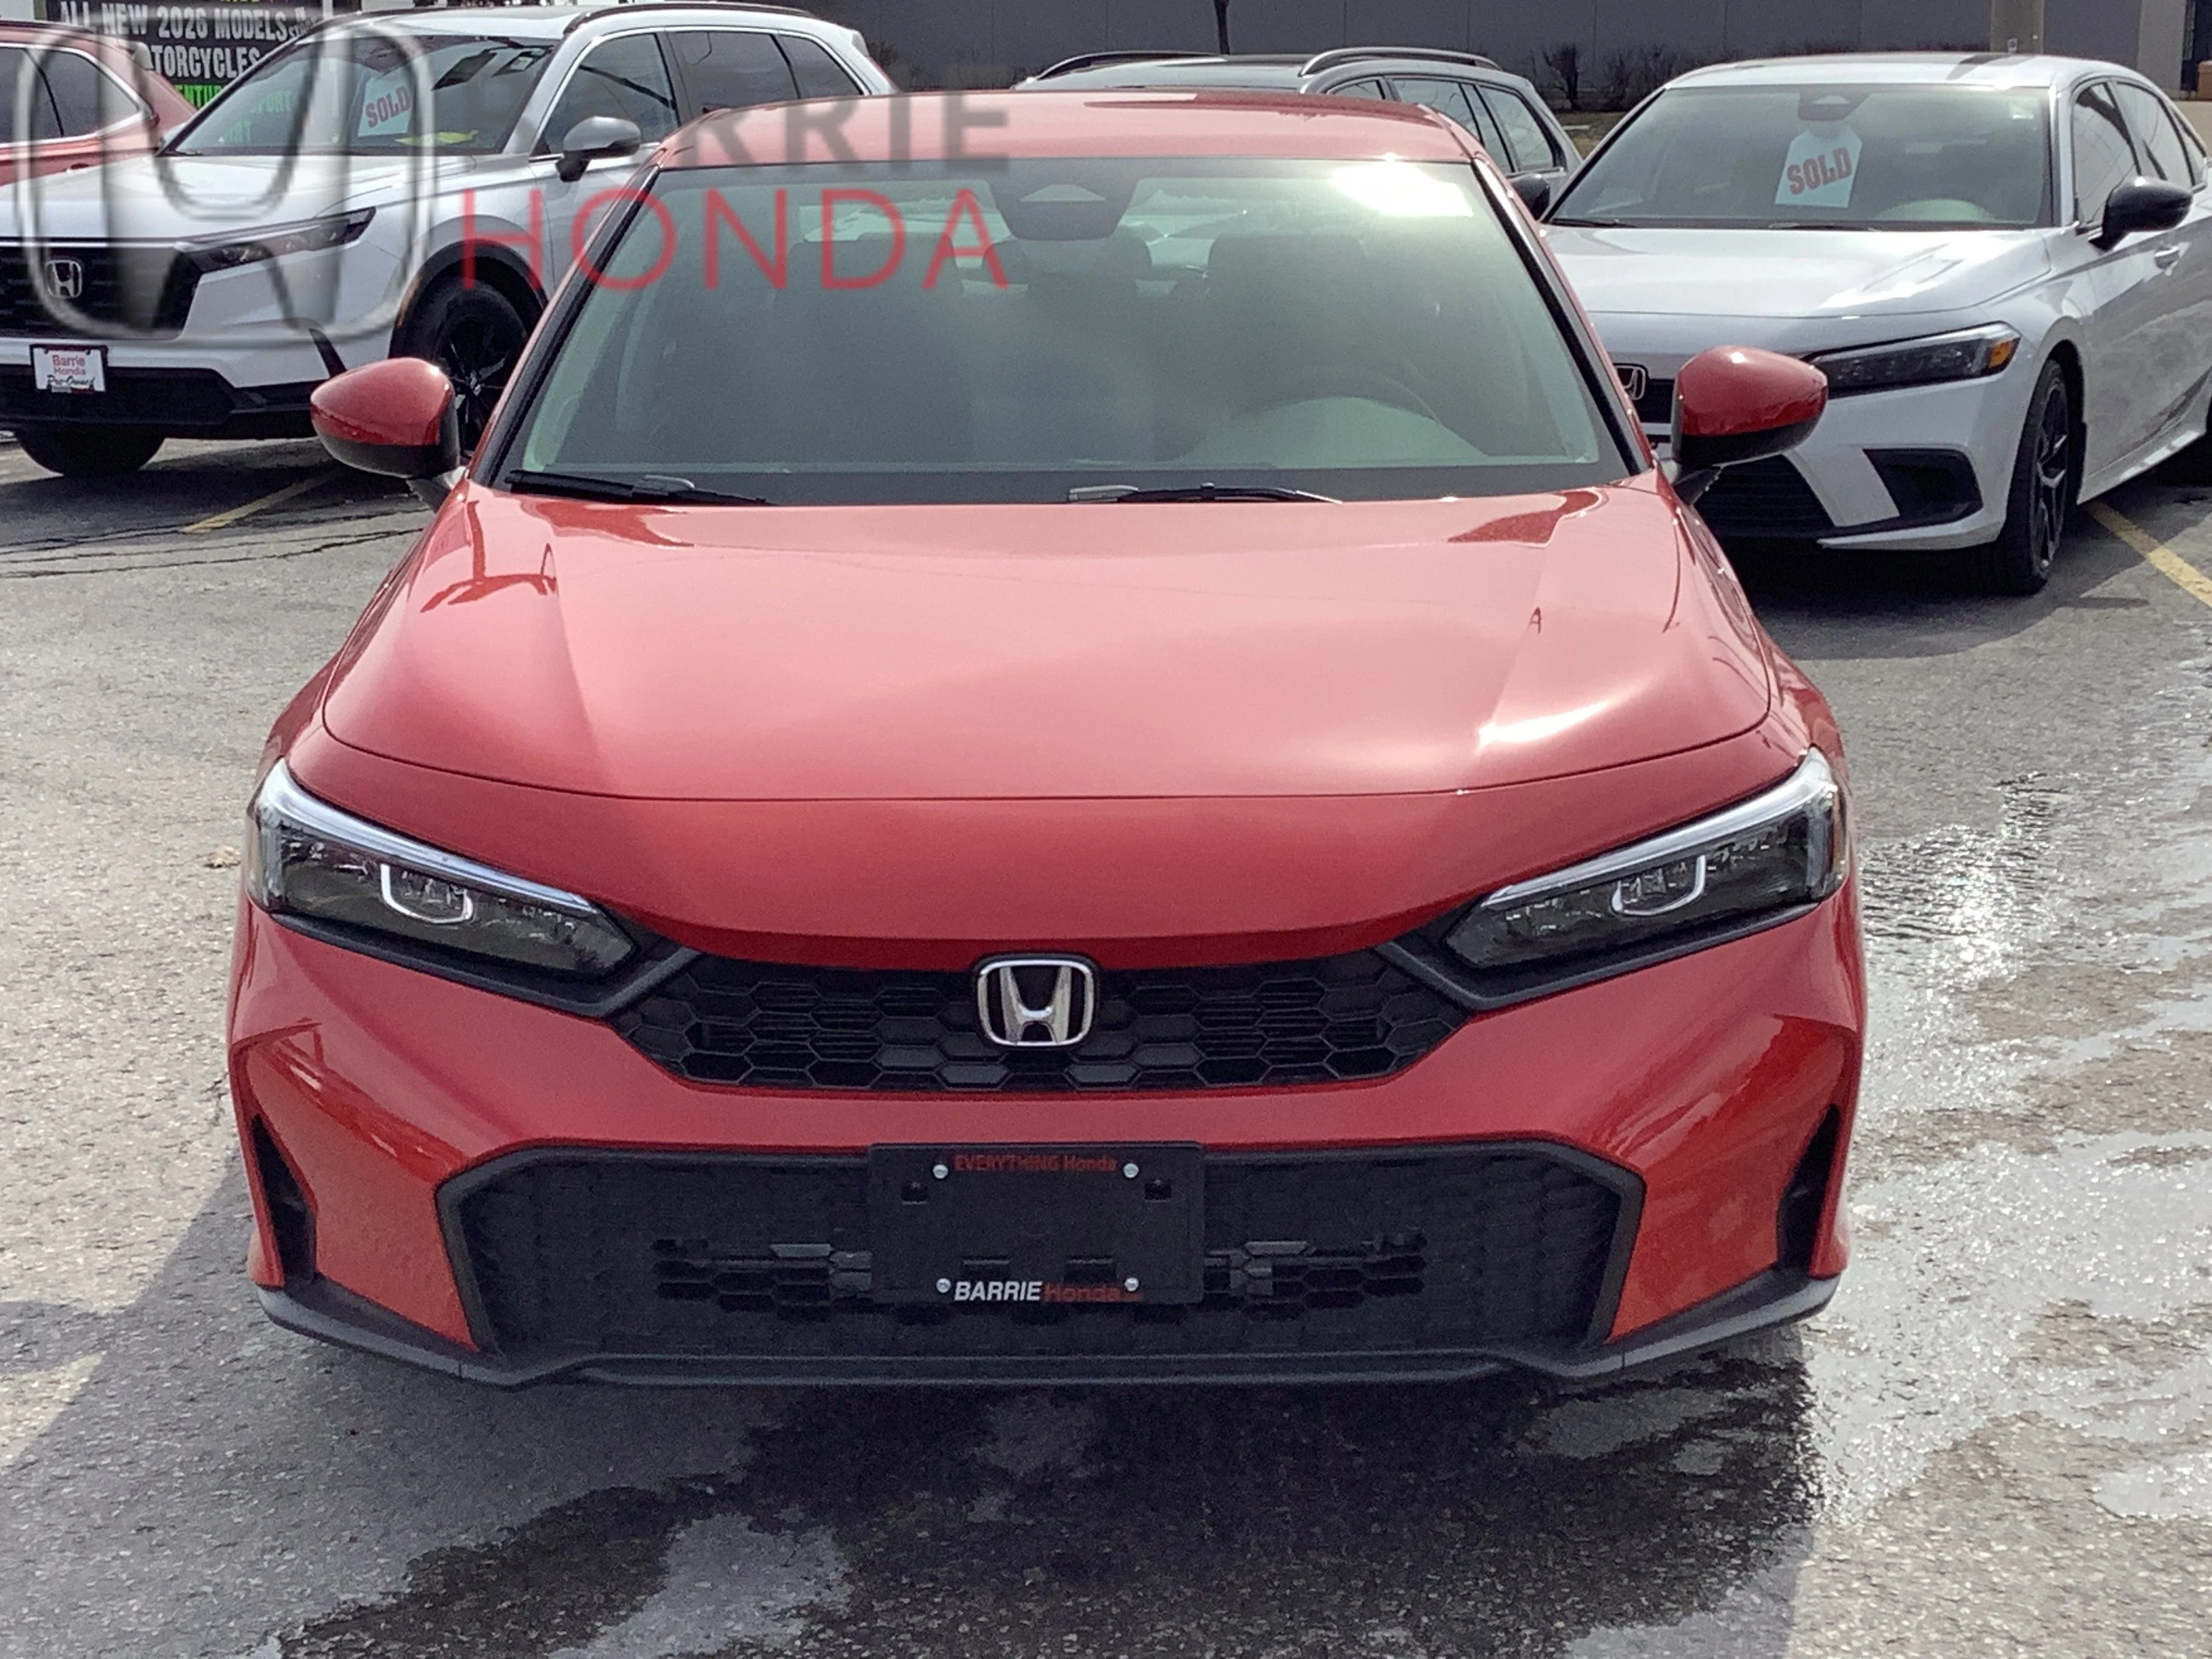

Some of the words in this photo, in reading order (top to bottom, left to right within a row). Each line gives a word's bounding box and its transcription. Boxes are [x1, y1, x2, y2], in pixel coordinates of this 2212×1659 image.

[102, 3, 148, 35] NEW
[157, 5, 208, 39] 2026
[214, 7, 287, 41] MODELS
[150, 45, 261, 79] TORCYCLES
[365, 85, 411, 128] SOLD
[1786, 146, 1853, 195] SOLD
[52, 354, 86, 367] Barrie
[1063, 1155, 1118, 1172] Honda
[954, 1281, 1042, 1301] BARRIE
[1044, 1283, 1122, 1303] Honda
